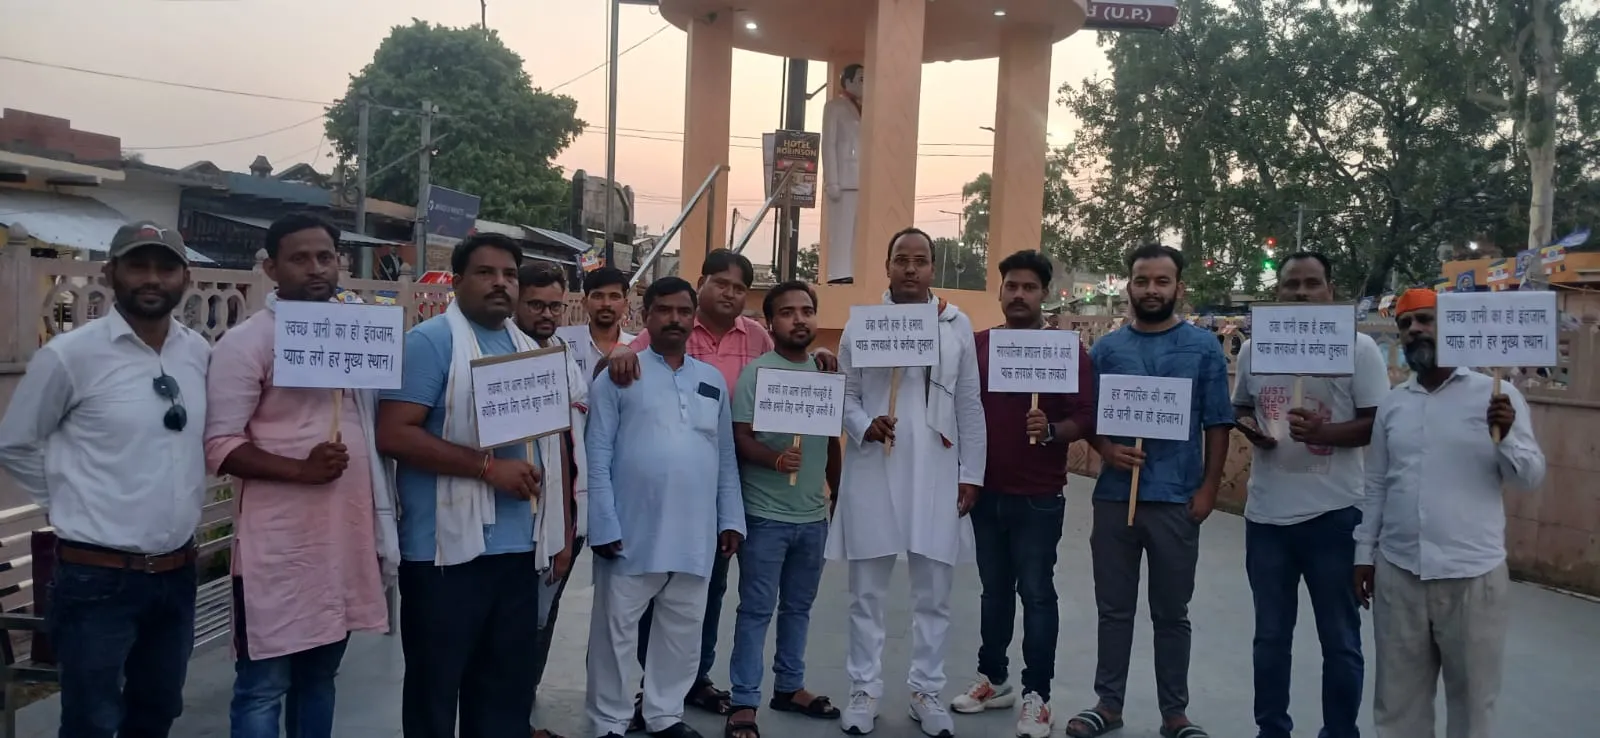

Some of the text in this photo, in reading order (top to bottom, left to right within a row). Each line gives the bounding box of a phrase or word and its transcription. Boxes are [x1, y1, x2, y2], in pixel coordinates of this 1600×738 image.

[1104, 6, 1151, 22] (U.P.)
[777, 147, 816, 157] ROBINSON
[784, 140, 811, 149] HOTEL
[1446, 310, 1466, 323] स्वच्छ
[1471, 305, 1487, 324] पानी
[1491, 310, 1502, 323] का
[1506, 306, 1514, 324] हो
[285, 318, 395, 344] स्वच्छ पानी का हो इंतजाम,
[866, 316, 875, 331] ठंडा
[878, 315, 889, 331] पानी
[891, 320, 900, 331] हक
[903, 315, 907, 331] है
[1269, 318, 1280, 333] ठंडा
[1283, 317, 1296, 333] पानी
[1299, 322, 1309, 334] हक
[1312, 317, 1316, 334] है
[856, 336, 934, 354] प्याऊ लगवाओ ये कर्तव्य तुम्हारा
[1257, 339, 1349, 360] प्याऊ लगवाओ ये कर्तव्य तुम्हारा
[1446, 335, 1464, 349] प्याऊ
[1469, 330, 1482, 349] लगे
[1487, 335, 1497, 349] हर
[1501, 335, 1519, 354] मुख्य
[283, 349, 305, 365] प्याऊ
[309, 345, 324, 367] लगे
[329, 351, 340, 367] हर
[344, 352, 363, 373] मुख्य
[1001, 367, 1013, 379] प्याऊ
[1035, 368, 1046, 380] प्याऊ
[1112, 388, 1120, 400] हर
[1124, 387, 1148, 401] नागरिक
[1151, 388, 1160, 403] की
[1259, 396, 1292, 404] ENJOY
[1117, 406, 1131, 420] पानी
[1134, 411, 1143, 421] का
[1146, 408, 1153, 422] हो
